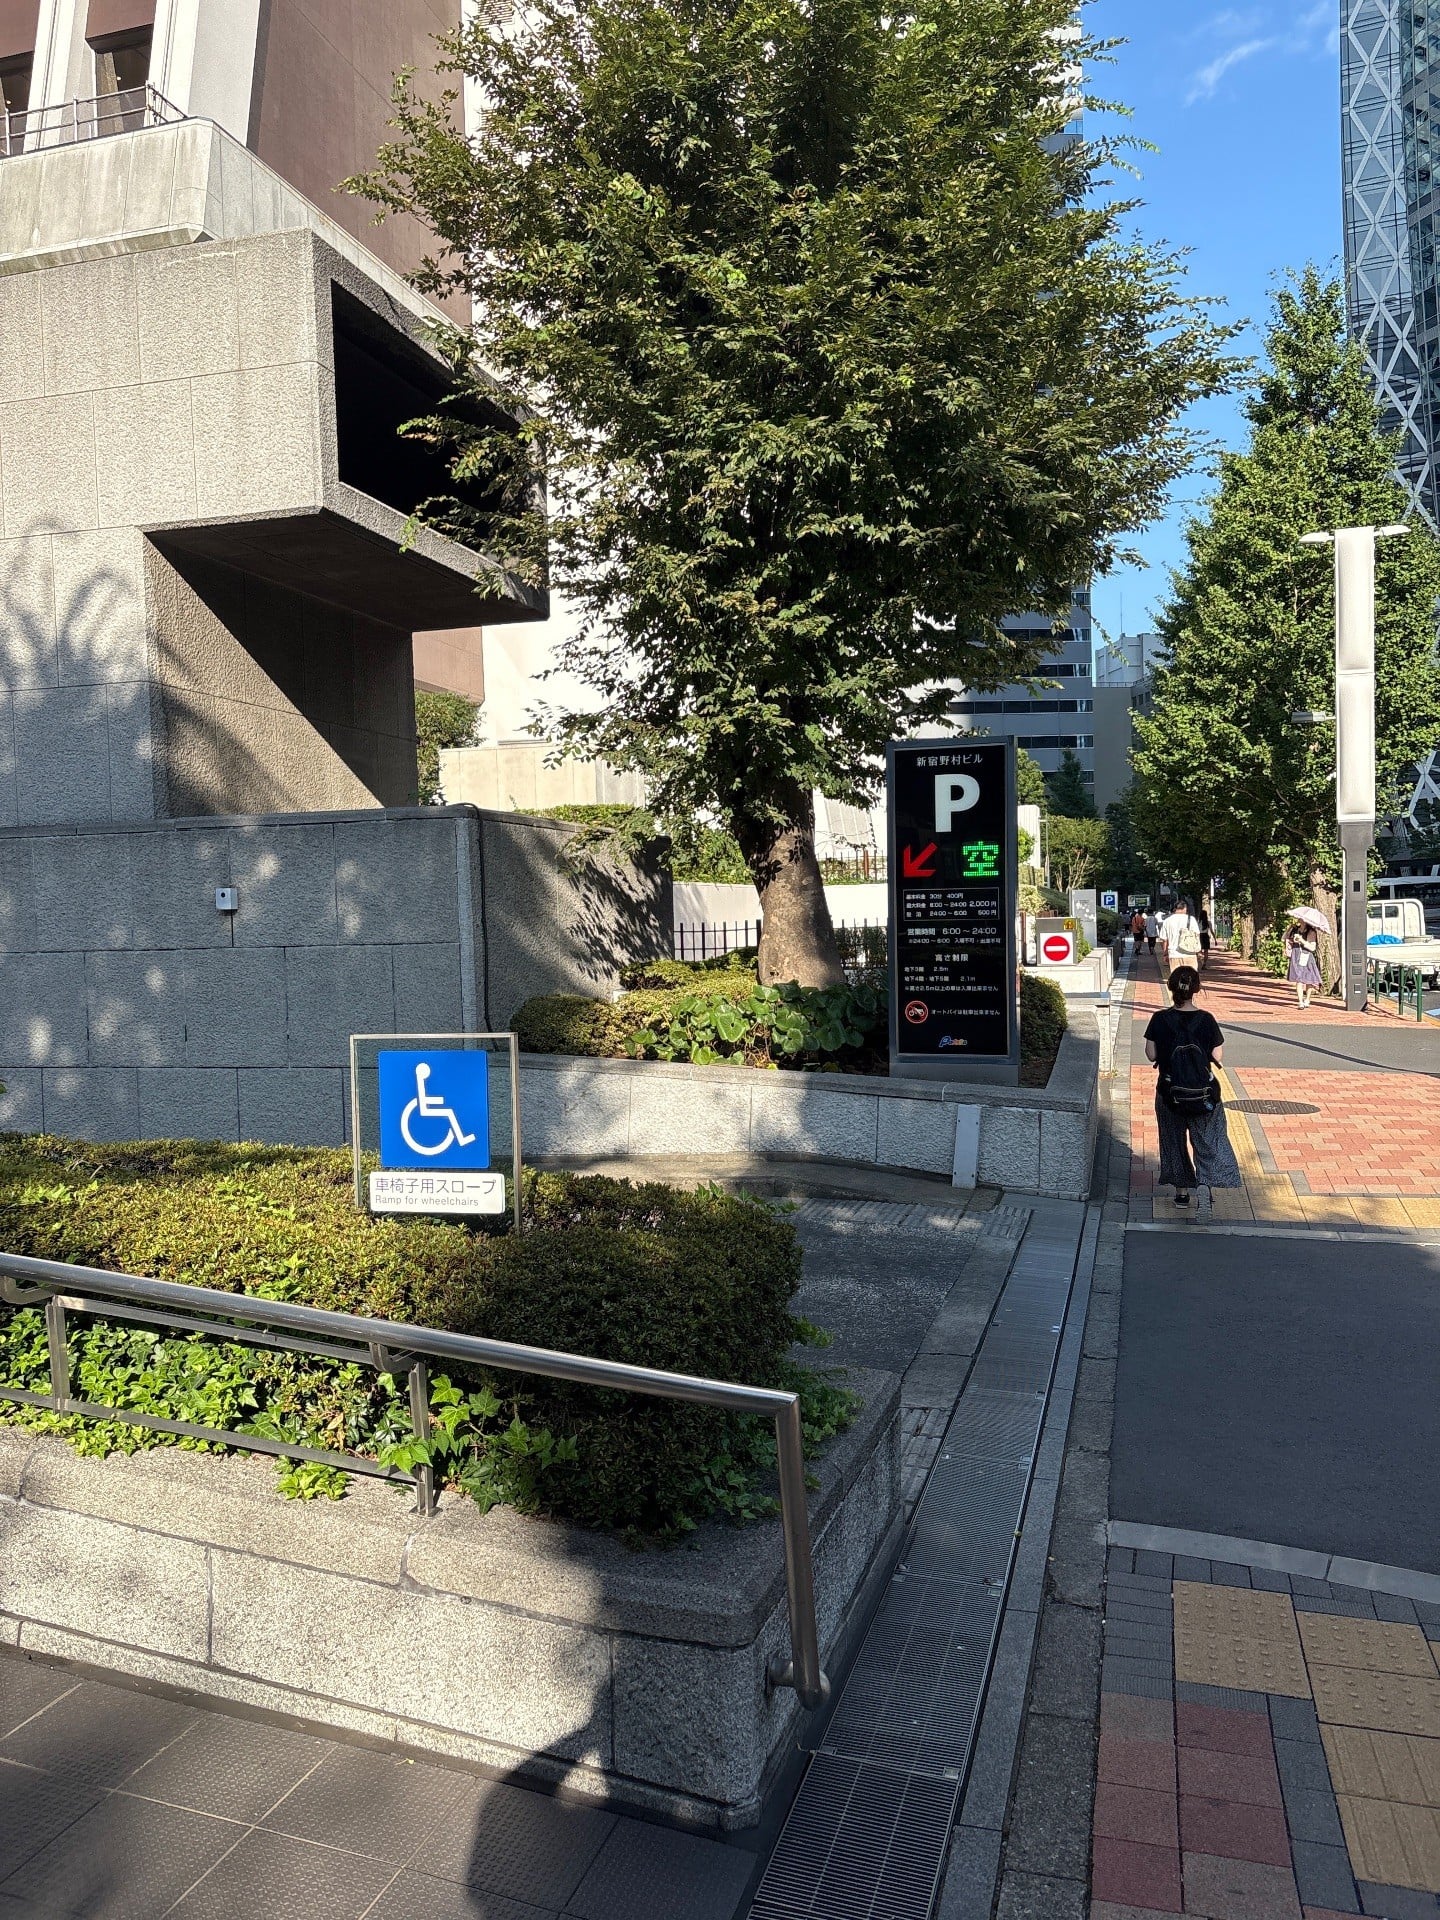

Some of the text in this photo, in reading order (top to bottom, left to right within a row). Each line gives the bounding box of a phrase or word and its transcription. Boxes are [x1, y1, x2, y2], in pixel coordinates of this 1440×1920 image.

[917, 754, 983, 767] 新宿野村ビル
[935, 774, 980, 832] P
[963, 841, 1000, 877] 空
[935, 954, 968, 962] 高さ制限
[376, 1178, 496, 1194] 車椅子用スロープ
[375, 1195, 478, 1206] Ramp for wheelchairs
